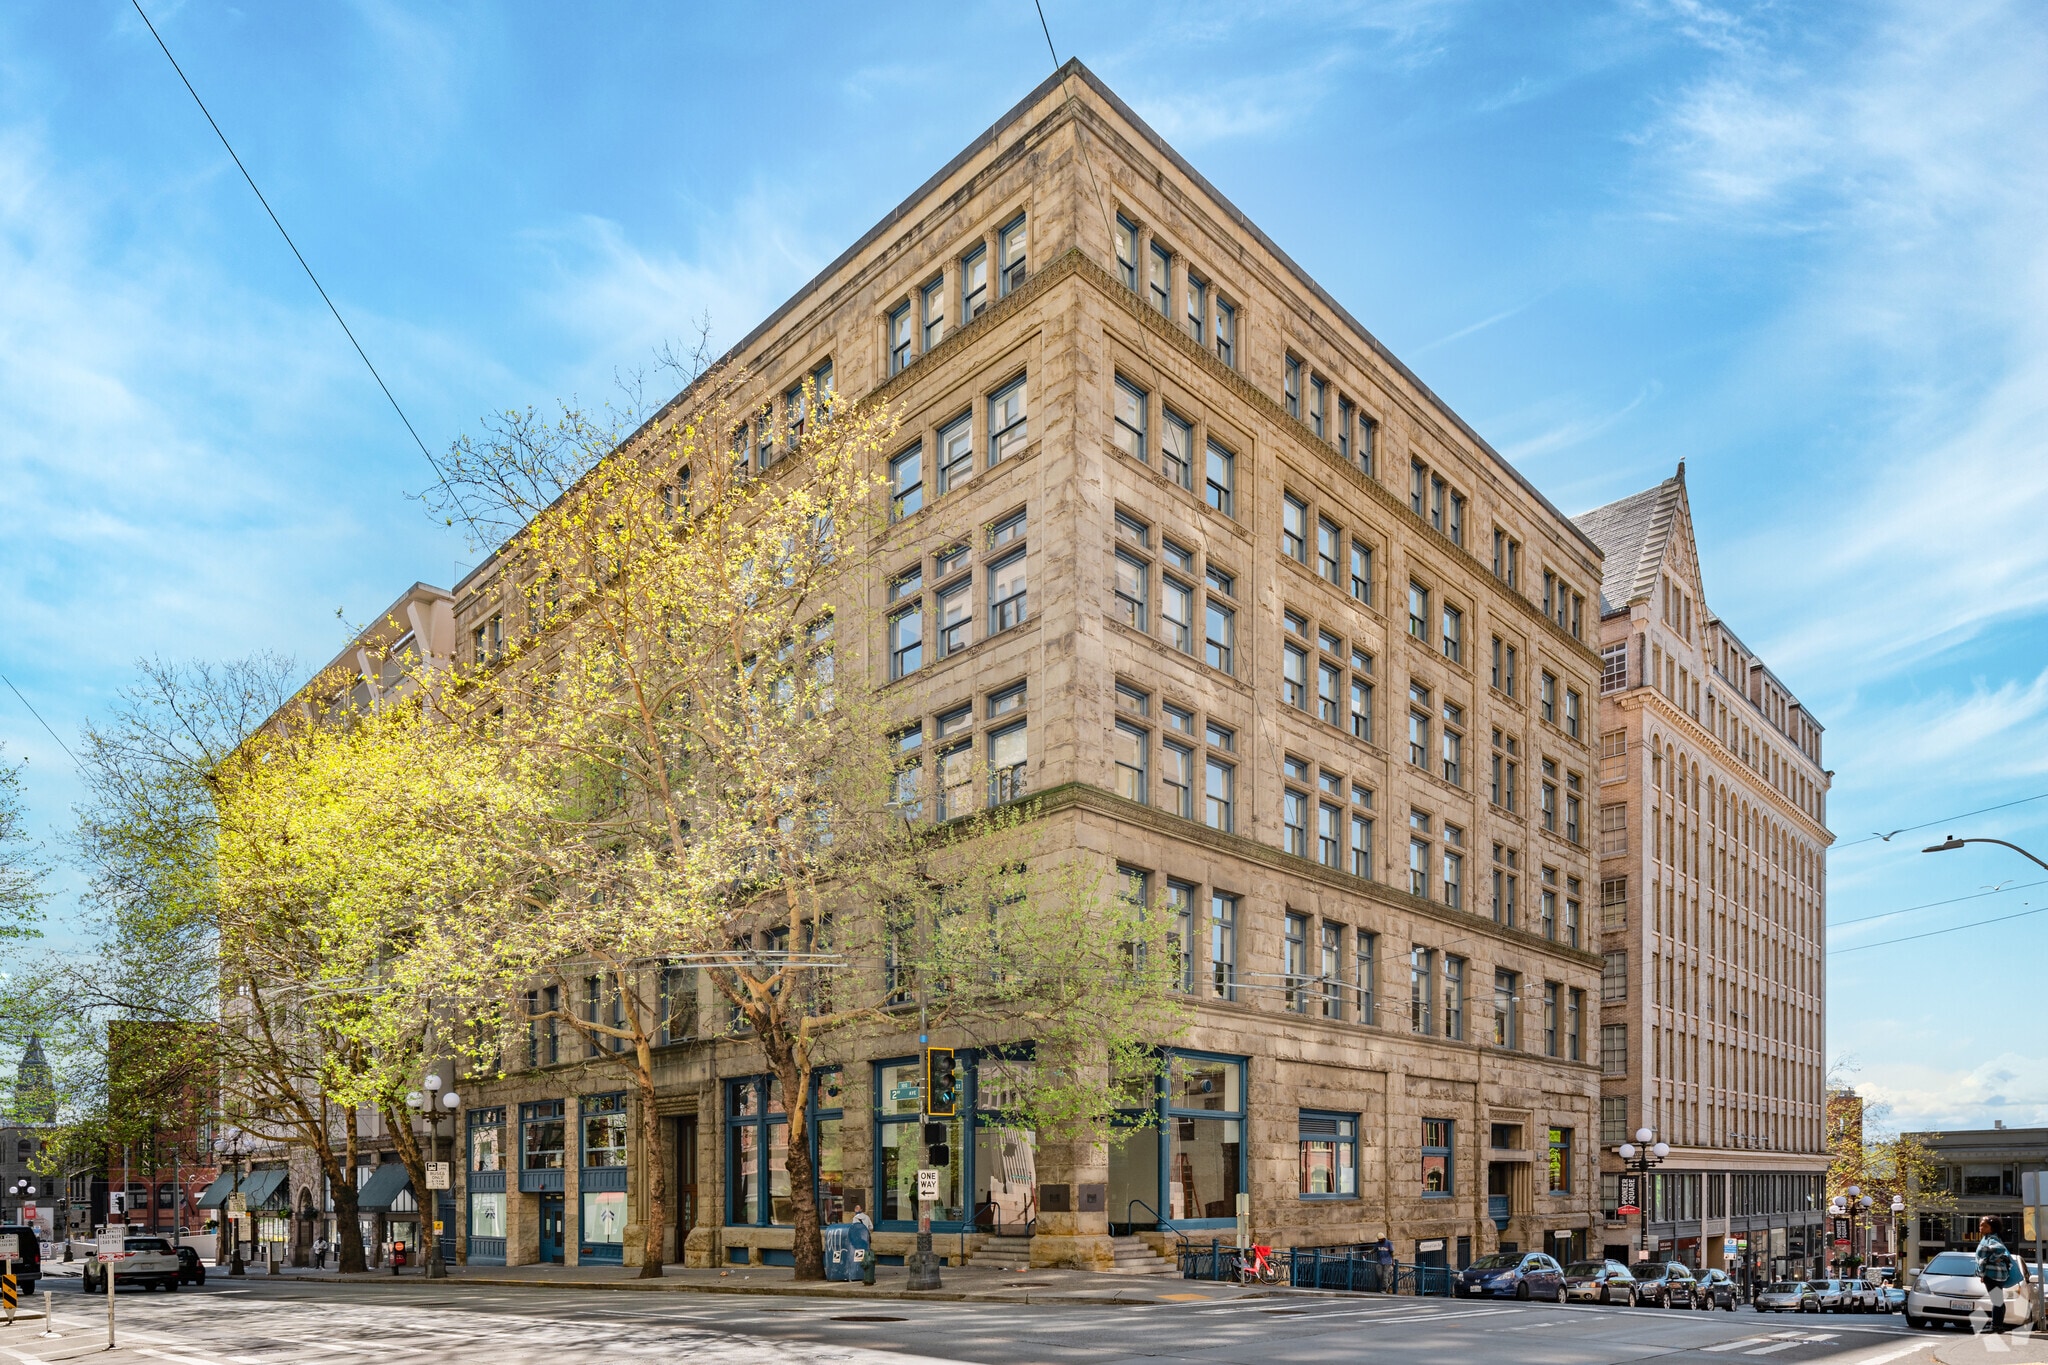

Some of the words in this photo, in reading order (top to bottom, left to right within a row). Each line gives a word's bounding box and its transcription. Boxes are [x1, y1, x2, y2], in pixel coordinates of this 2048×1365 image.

[920, 1172, 936, 1180] ONE
[920, 1180, 937, 1188] WAY
[1621, 1178, 1629, 1205] PIONEER
[1628, 1178, 1636, 1205] SQUARE
